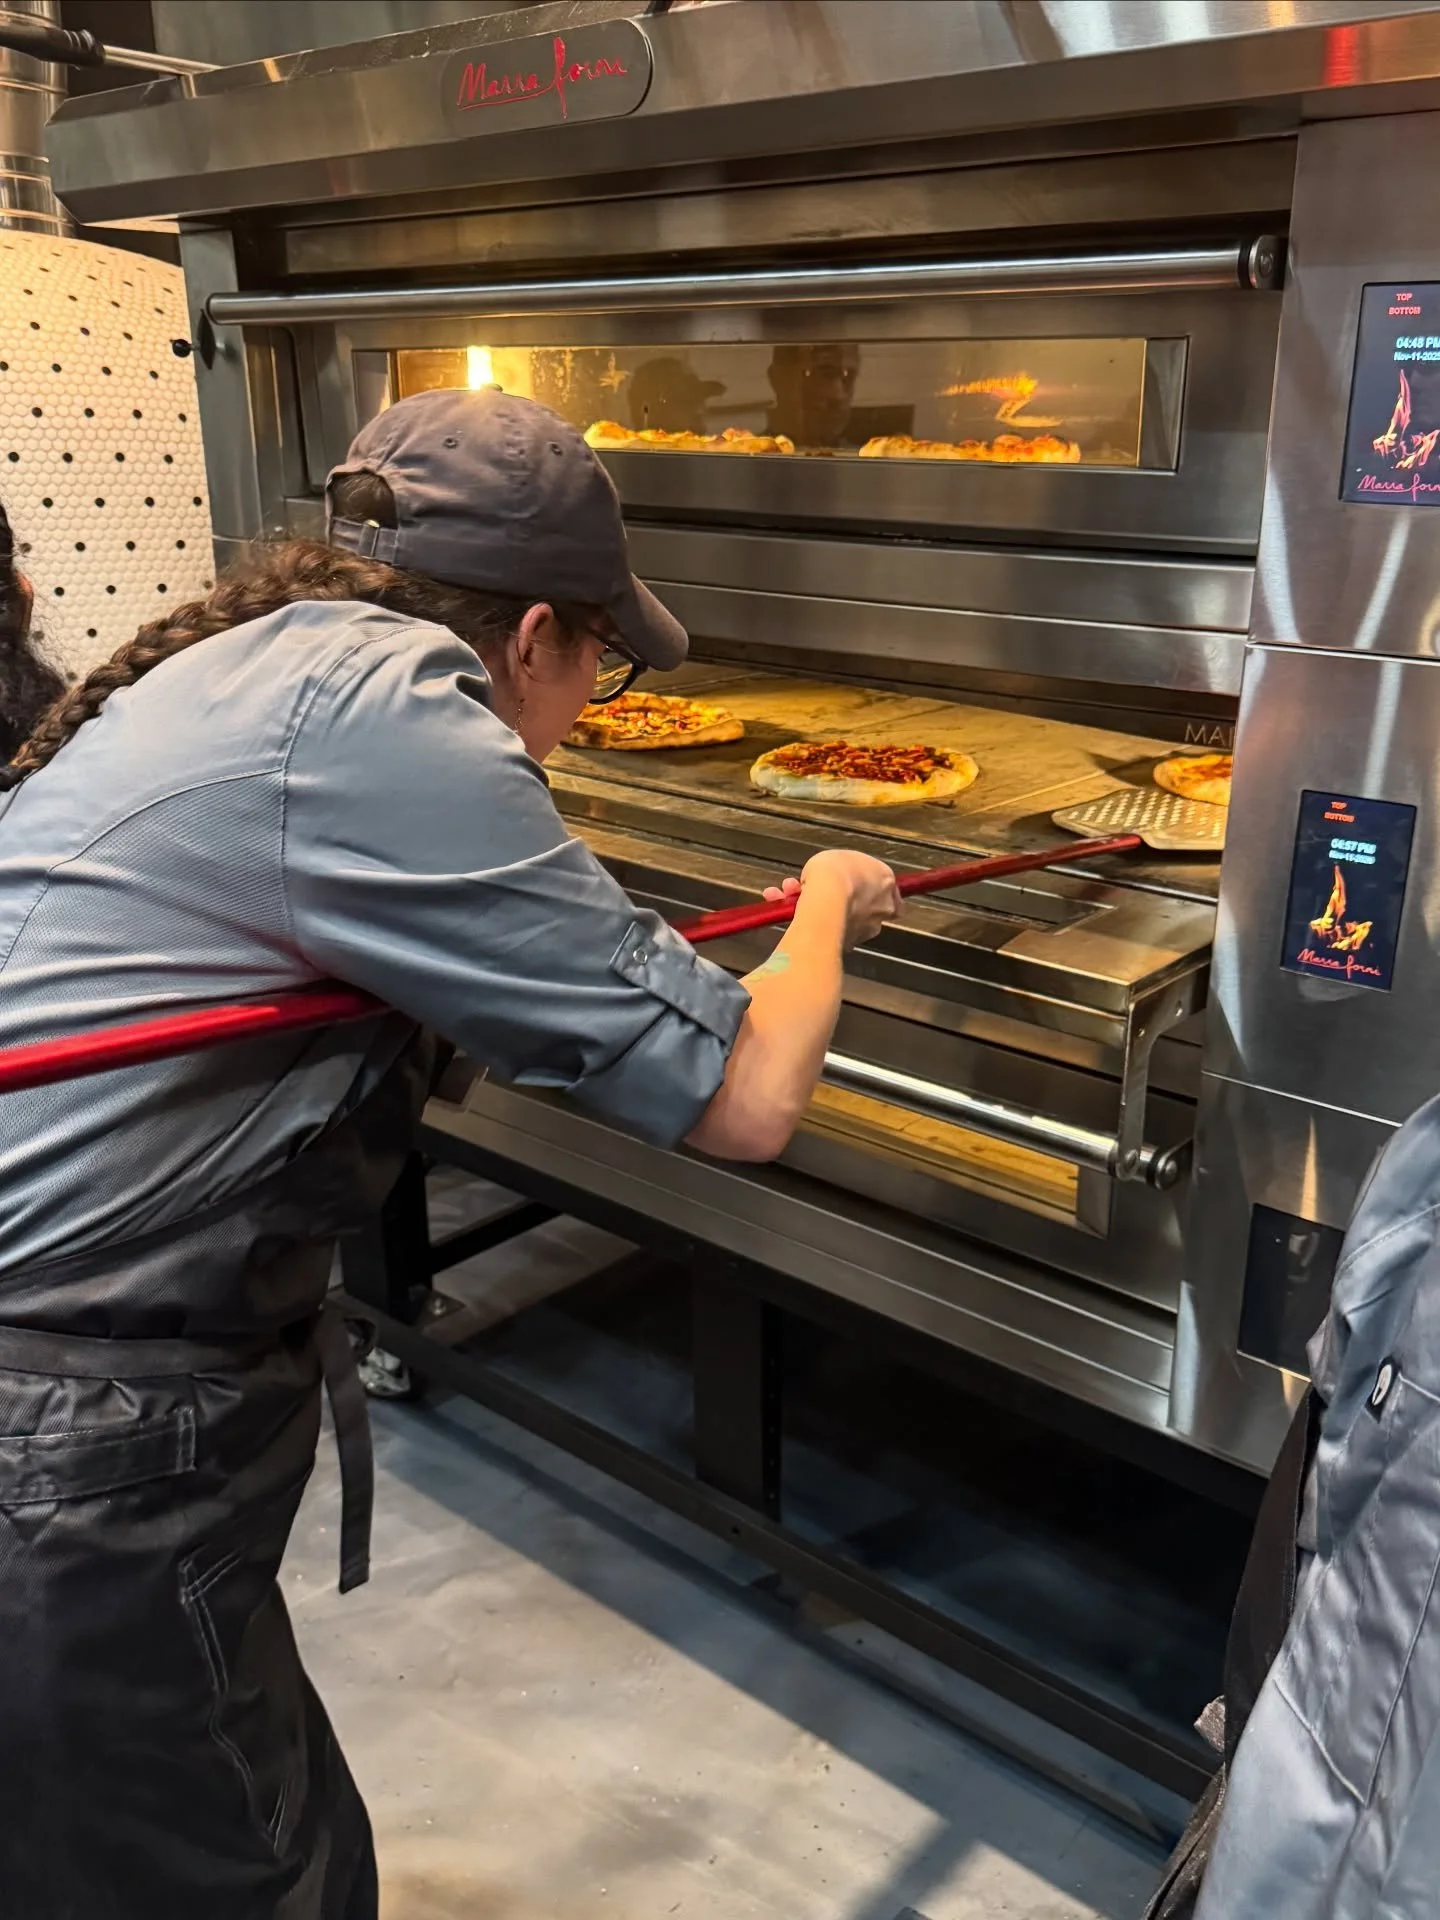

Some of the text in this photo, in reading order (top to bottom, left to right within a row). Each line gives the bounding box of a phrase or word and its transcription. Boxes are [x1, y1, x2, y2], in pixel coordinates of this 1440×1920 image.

[456, 62, 542, 109] Marra
[1396, 292, 1413, 302] TOP
[1388, 305, 1421, 315] BOTTOM
[1357, 474, 1405, 492] Marra
[1331, 801, 1347, 810] TOP
